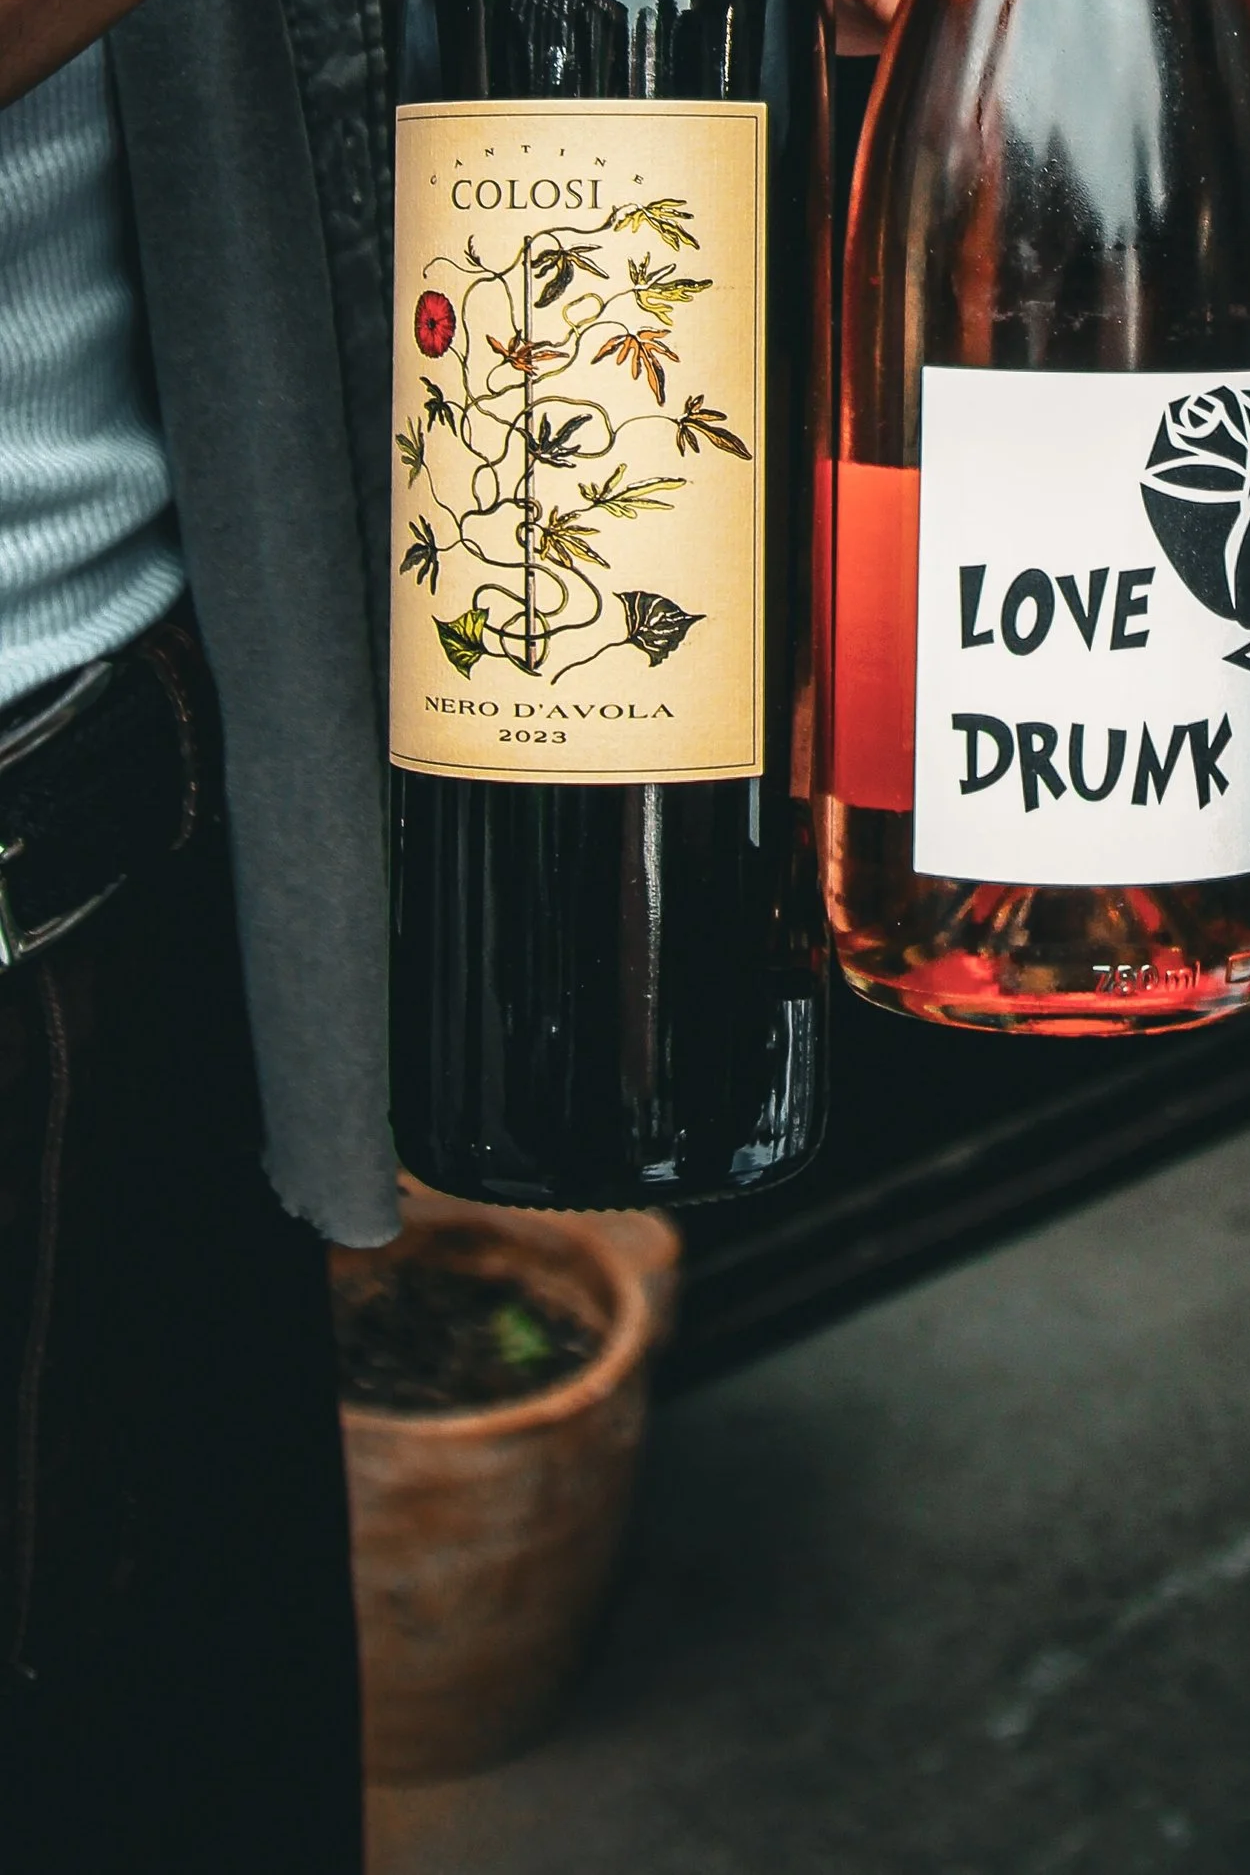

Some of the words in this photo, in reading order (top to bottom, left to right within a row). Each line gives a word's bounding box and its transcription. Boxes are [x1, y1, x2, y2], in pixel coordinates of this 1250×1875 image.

[430, 144, 644, 186] CANTINE
[451, 179, 602, 210] COLOSI
[959, 565, 1156, 656] LOVE
[425, 696, 499, 717] NERO
[514, 703, 675, 719] D'AVOLA
[499, 729, 567, 744] 2023
[951, 712, 1233, 813] DRUNK
